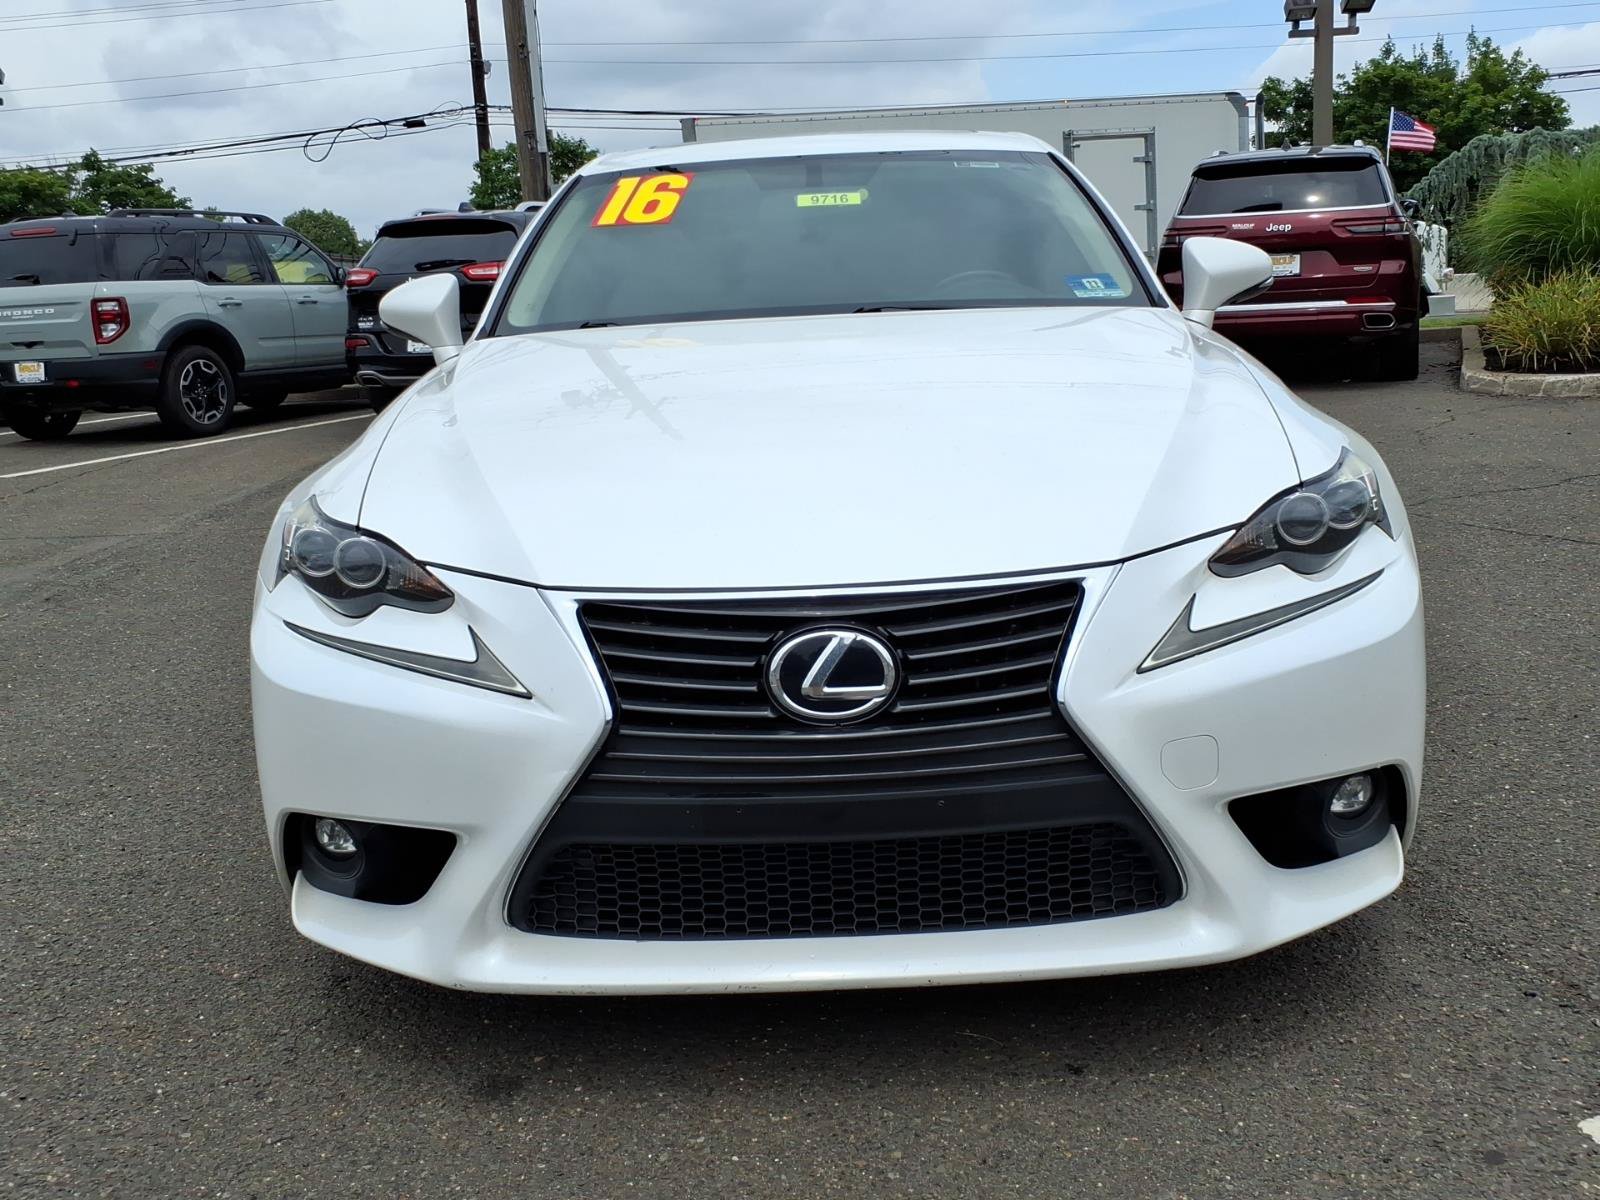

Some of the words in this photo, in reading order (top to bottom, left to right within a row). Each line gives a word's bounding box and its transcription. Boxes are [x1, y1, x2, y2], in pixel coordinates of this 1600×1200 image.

[597, 173, 689, 225] 16
[810, 193, 849, 204] 9716
[1265, 222, 1292, 232] Jeep
